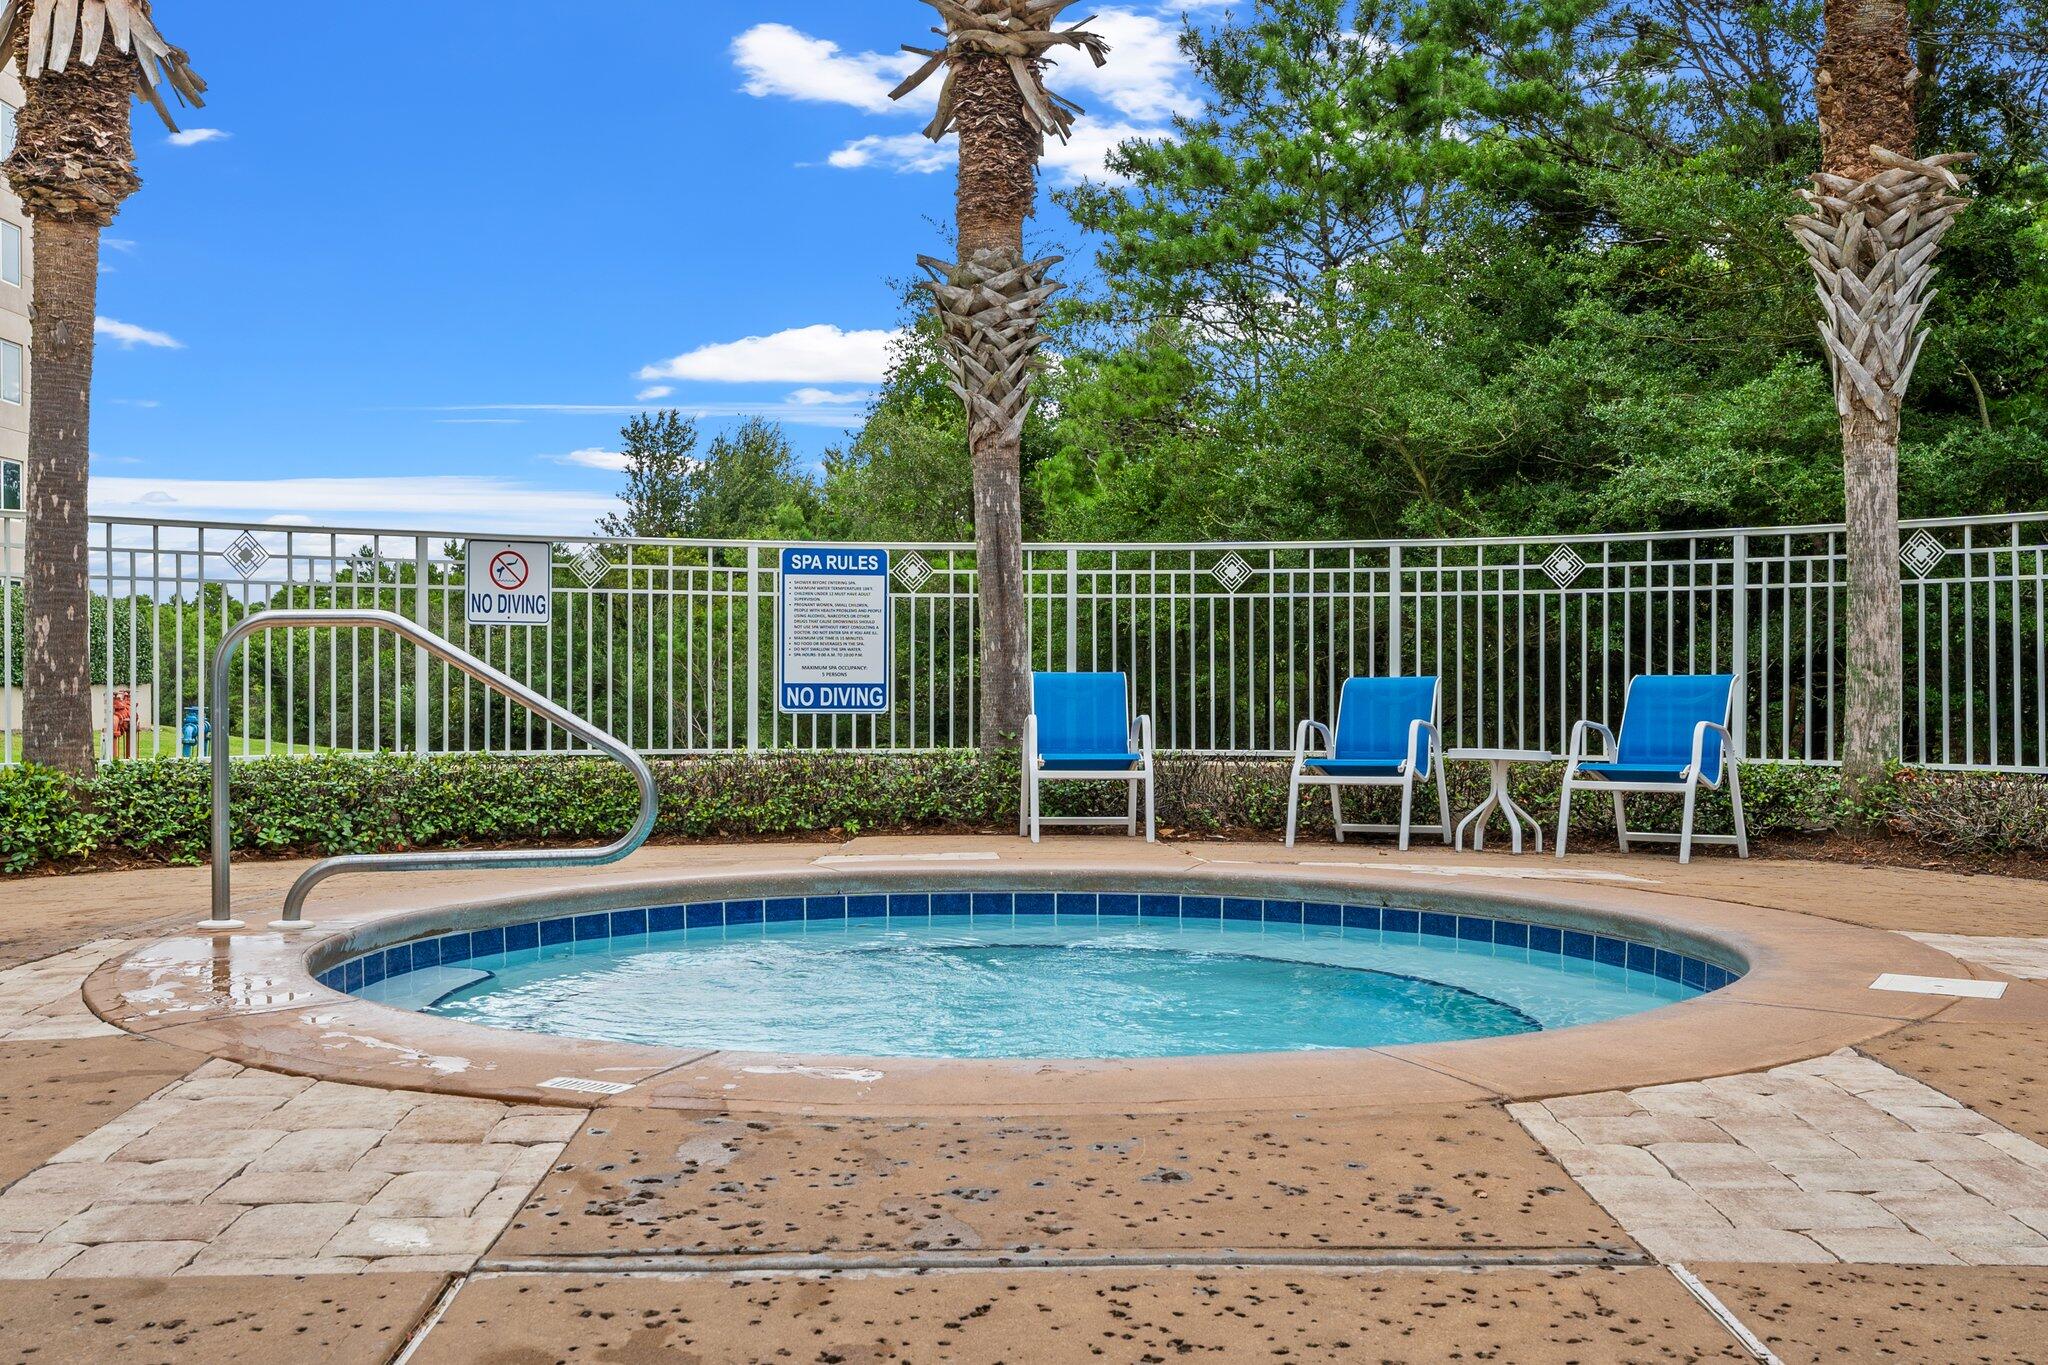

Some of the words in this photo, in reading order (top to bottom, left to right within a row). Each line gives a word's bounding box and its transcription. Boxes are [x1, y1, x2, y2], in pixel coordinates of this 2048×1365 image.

[791, 554, 822, 571] SPA
[826, 554, 879, 571] RULES
[472, 593, 492, 613] NO
[498, 594, 546, 615] DIVING
[787, 686, 814, 707] NO
[820, 686, 883, 707] DIVING
